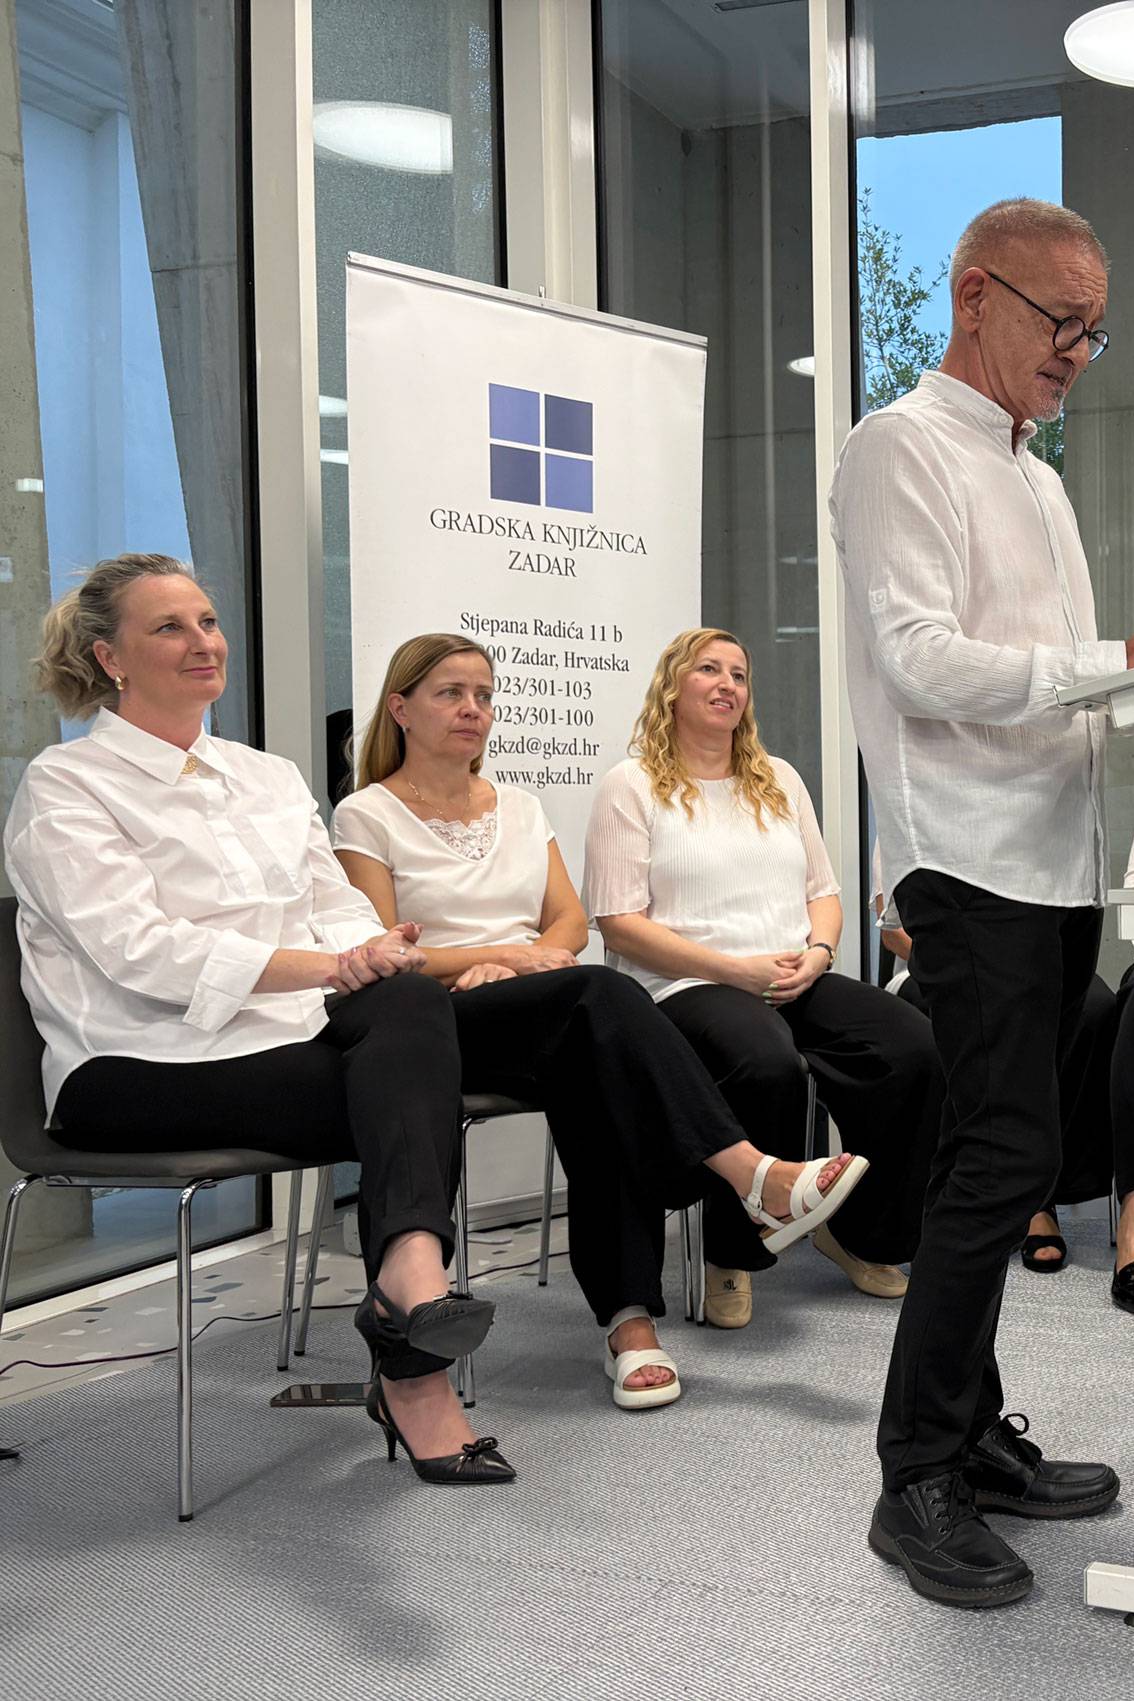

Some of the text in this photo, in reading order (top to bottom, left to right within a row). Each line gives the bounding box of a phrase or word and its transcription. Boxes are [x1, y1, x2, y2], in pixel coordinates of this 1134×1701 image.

[430, 508, 648, 555] GRADSKA KNJIŽNICA
[508, 549, 577, 577] ZADAR
[460, 612, 623, 643] Stjepana Radića 11 b
[511, 646, 559, 670] Zadar,
[564, 651, 630, 672] Hrvatska
[493, 675, 592, 700] 023/301-103
[493, 705, 594, 727] 023/301-100
[488, 735, 600, 760] gkzd@gkzd.hr
[496, 766, 594, 790] www.gkzd.hr
